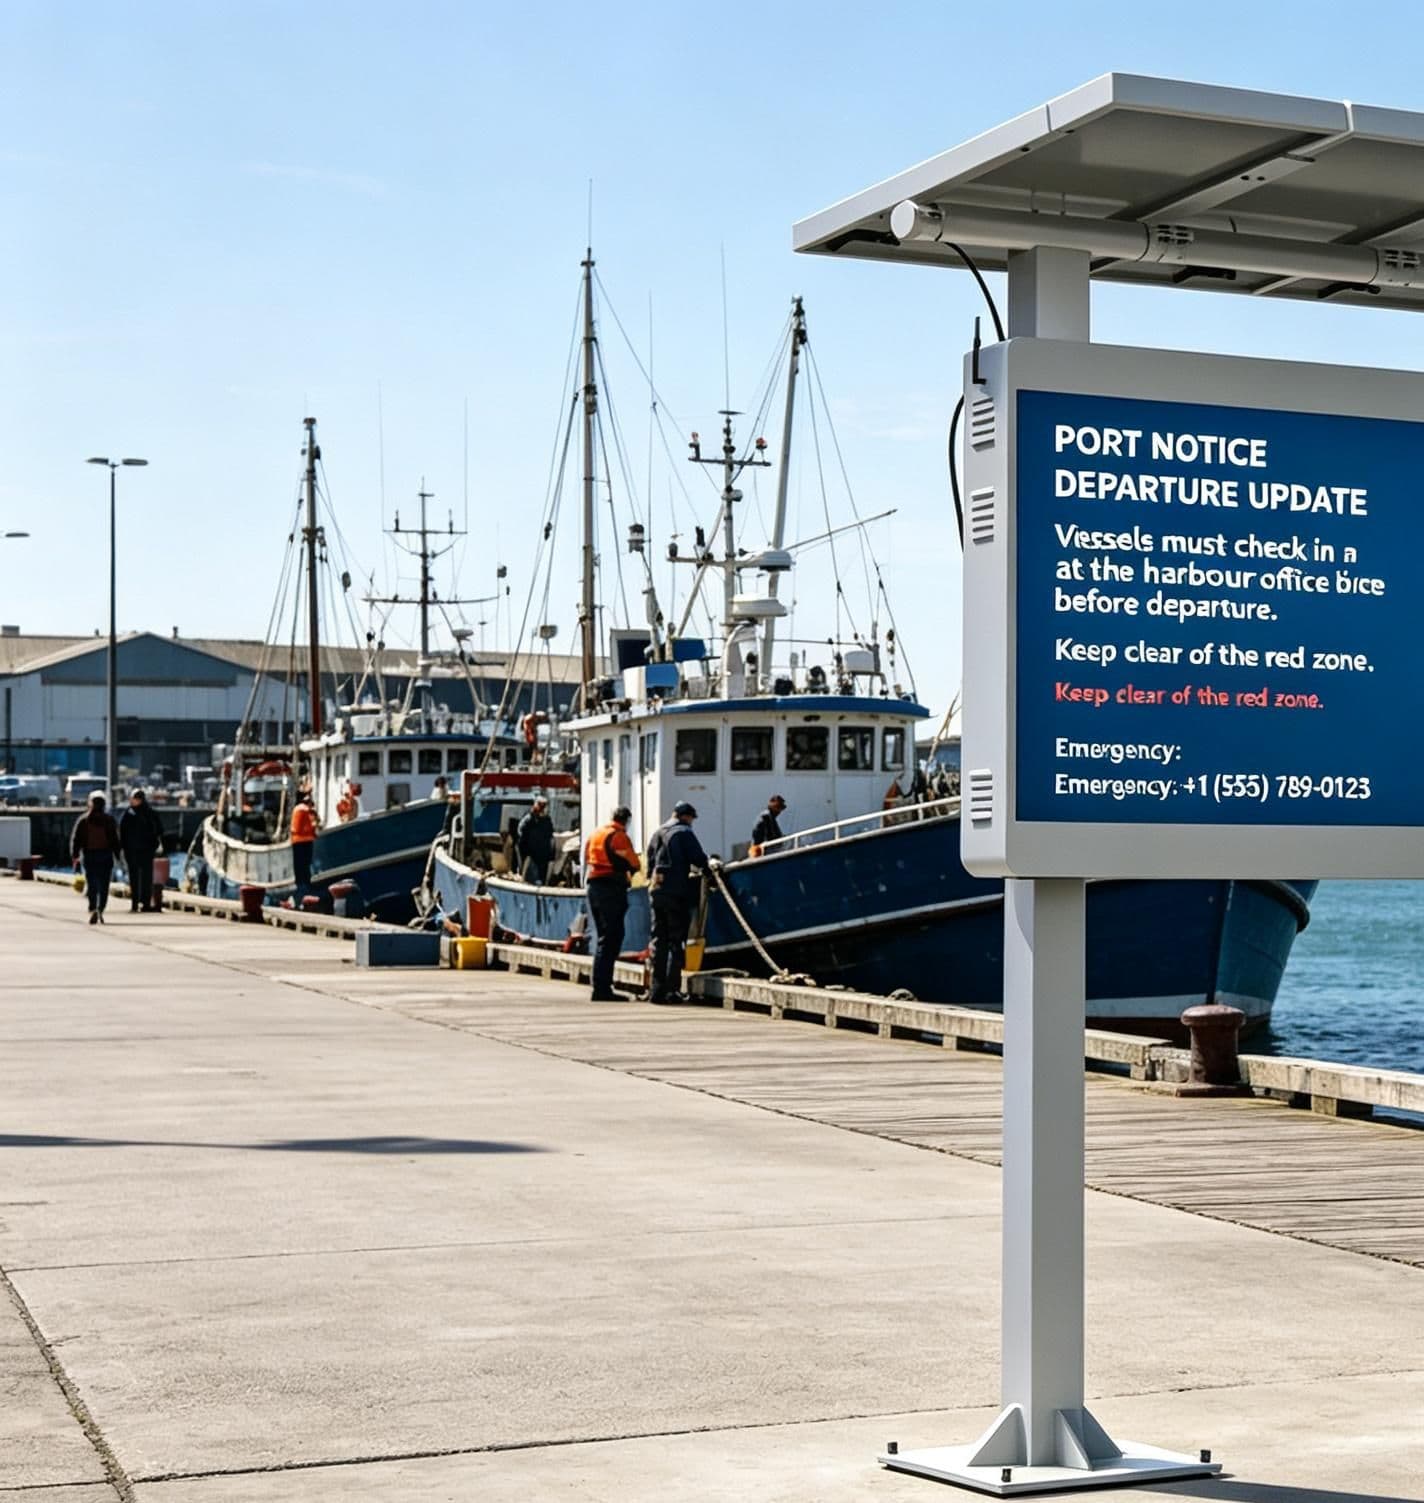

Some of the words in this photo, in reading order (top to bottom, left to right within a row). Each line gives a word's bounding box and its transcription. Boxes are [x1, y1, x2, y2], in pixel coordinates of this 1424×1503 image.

[1055, 424, 1143, 458] PORT
[1151, 431, 1267, 468] NOTICE
[1055, 469, 1239, 508] DEPARTURE
[1248, 481, 1368, 516] UPDATE
[1161, 533, 1228, 557] must
[1234, 533, 1308, 562] check
[1313, 537, 1335, 563] in
[1055, 558, 1085, 581] at
[1089, 555, 1135, 582] the
[1143, 557, 1258, 589] harbour
[1259, 566, 1330, 593] office
[1054, 586, 1140, 616] before
[1146, 589, 1278, 624] departure.
[1055, 637, 1117, 667] Keep
[1124, 639, 1184, 664] clear
[1189, 642, 1215, 665] of
[1217, 643, 1259, 667] the
[1264, 645, 1305, 669] red
[1312, 653, 1374, 673] zone.
[1055, 682, 1110, 708] Keep
[1115, 683, 1165, 704] clear
[1171, 685, 1192, 705] of
[1196, 685, 1230, 706] the
[1236, 687, 1268, 707] red
[1274, 693, 1324, 709] zone.
[1055, 737, 1181, 765] Emergency:
[1055, 773, 1179, 801] Emergency:
[1182, 774, 1208, 797] +1
[1213, 773, 1269, 803] (555)
[1275, 775, 1371, 800] 789-0123
